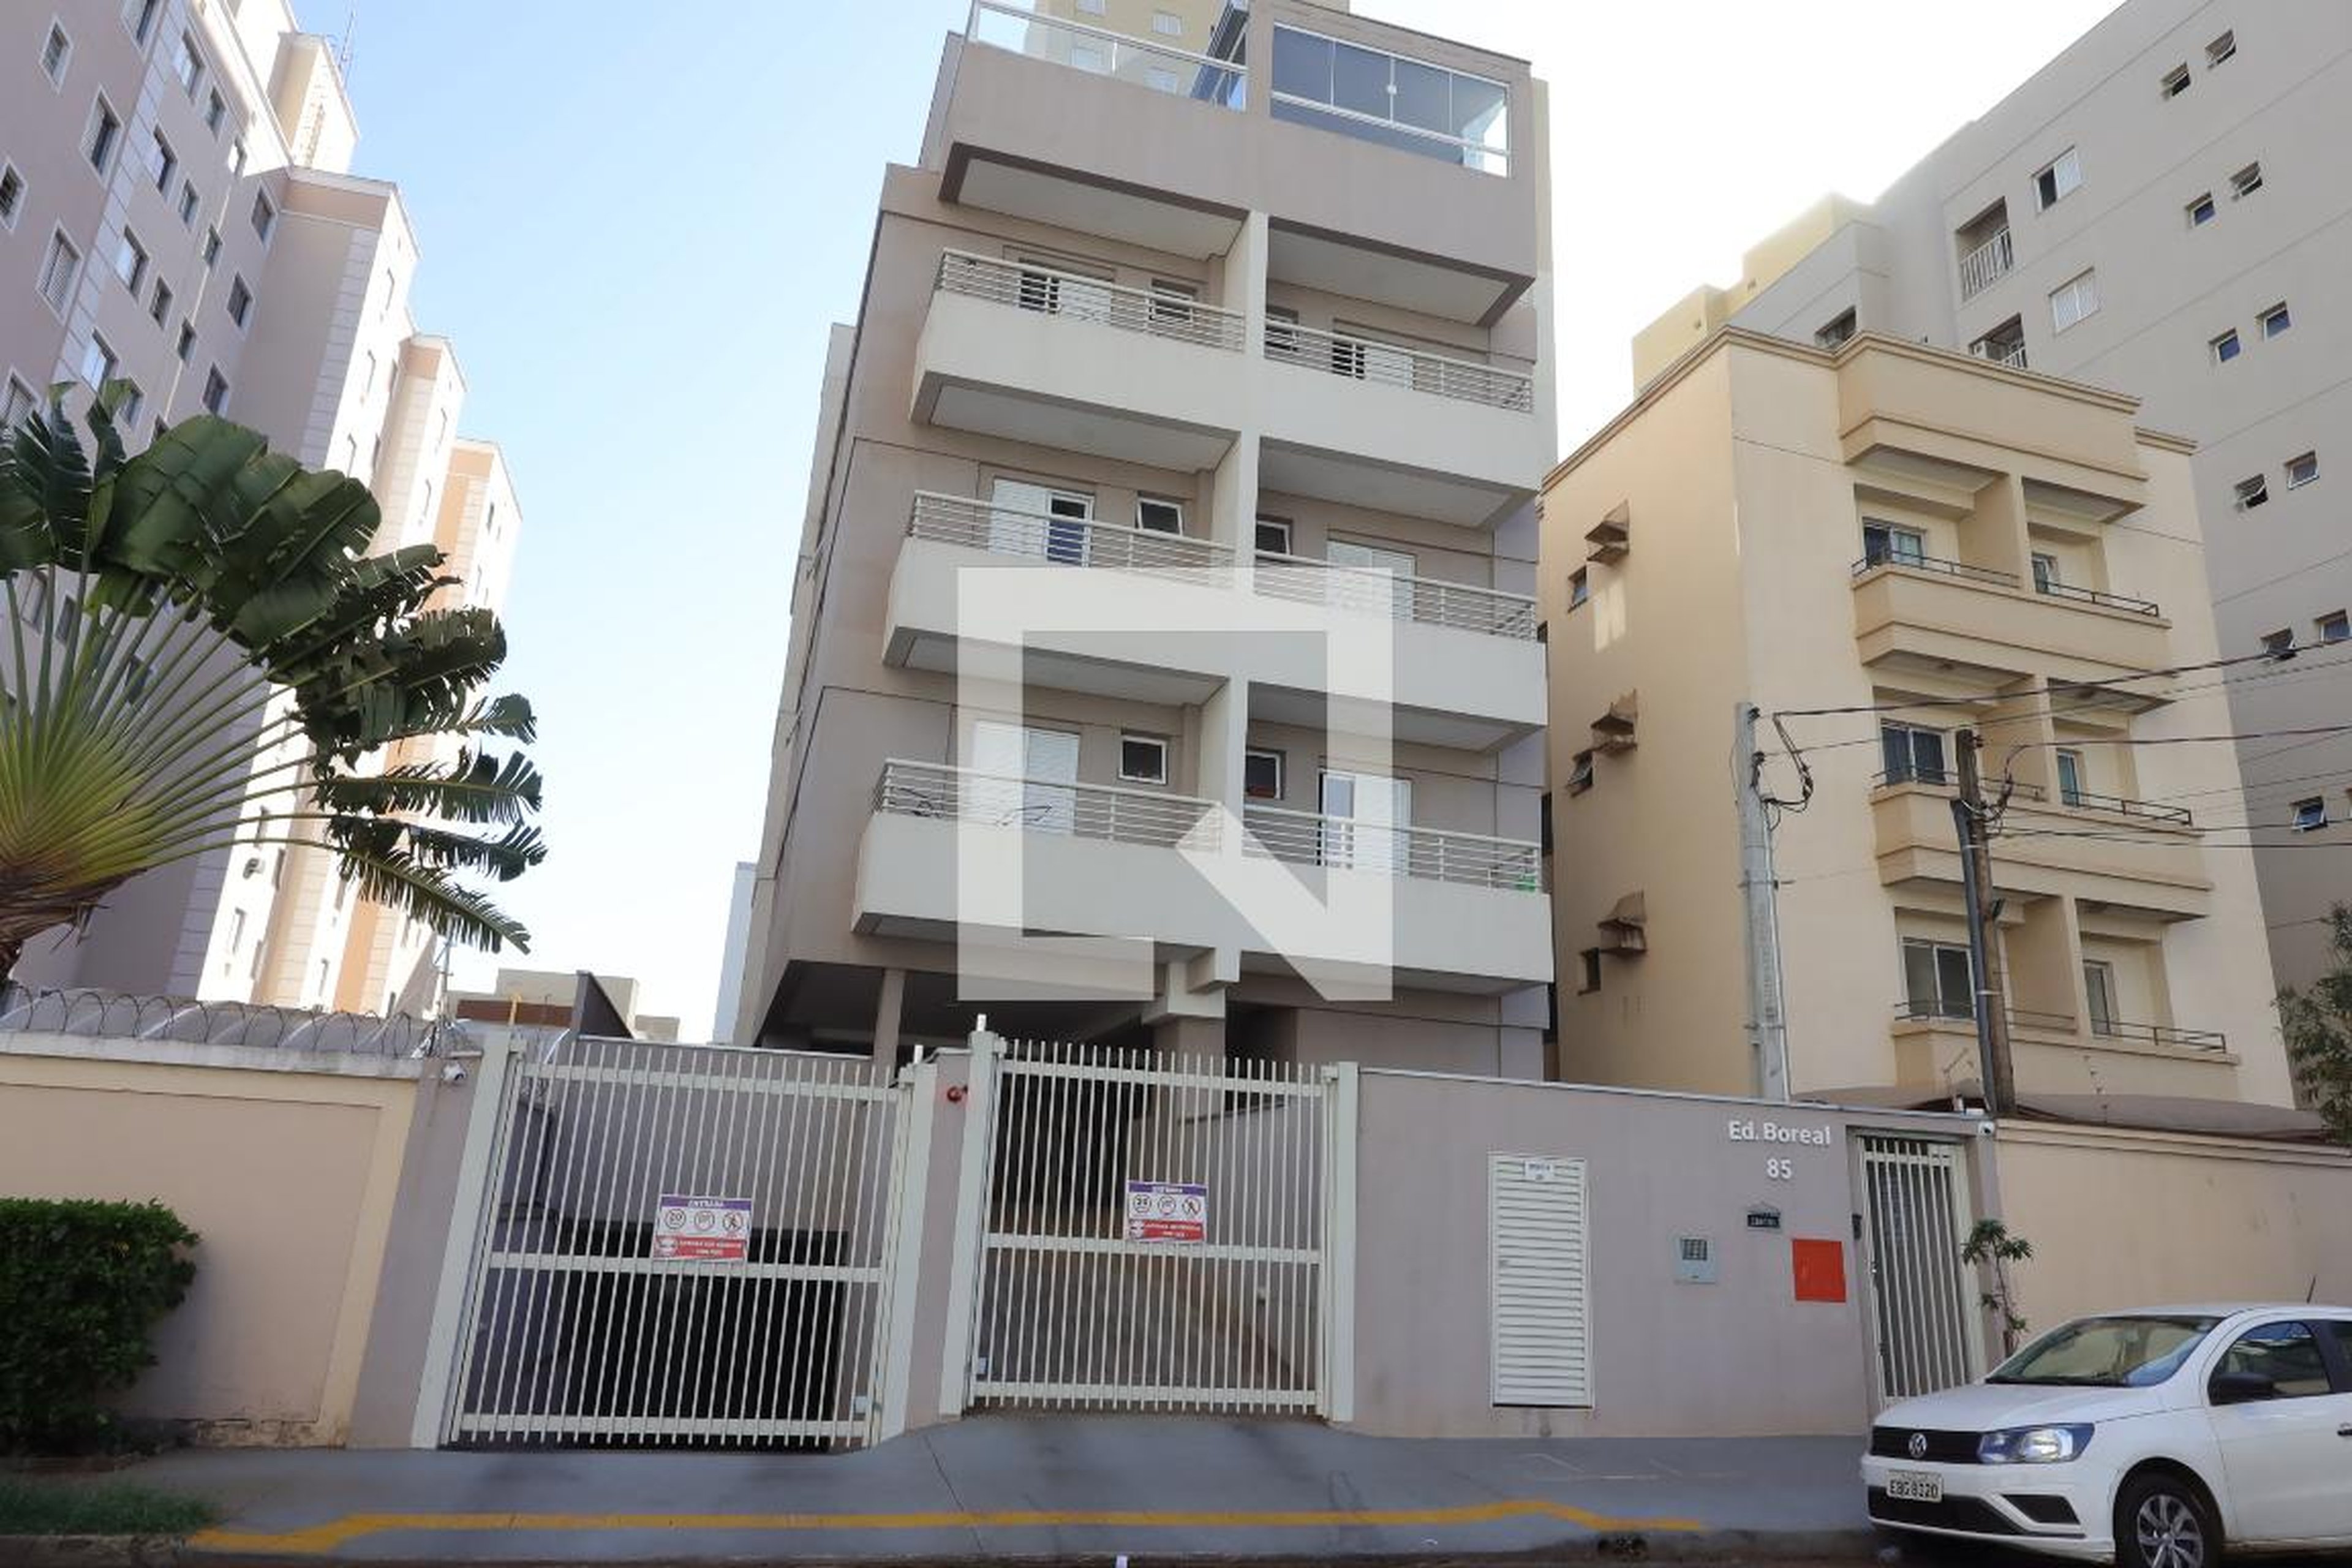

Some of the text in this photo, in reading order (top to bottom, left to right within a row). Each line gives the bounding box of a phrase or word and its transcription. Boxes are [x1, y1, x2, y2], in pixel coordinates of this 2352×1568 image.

[1729, 1121, 1830, 1144] Ed. Boreal
[1767, 1158, 1792, 1178] 85
